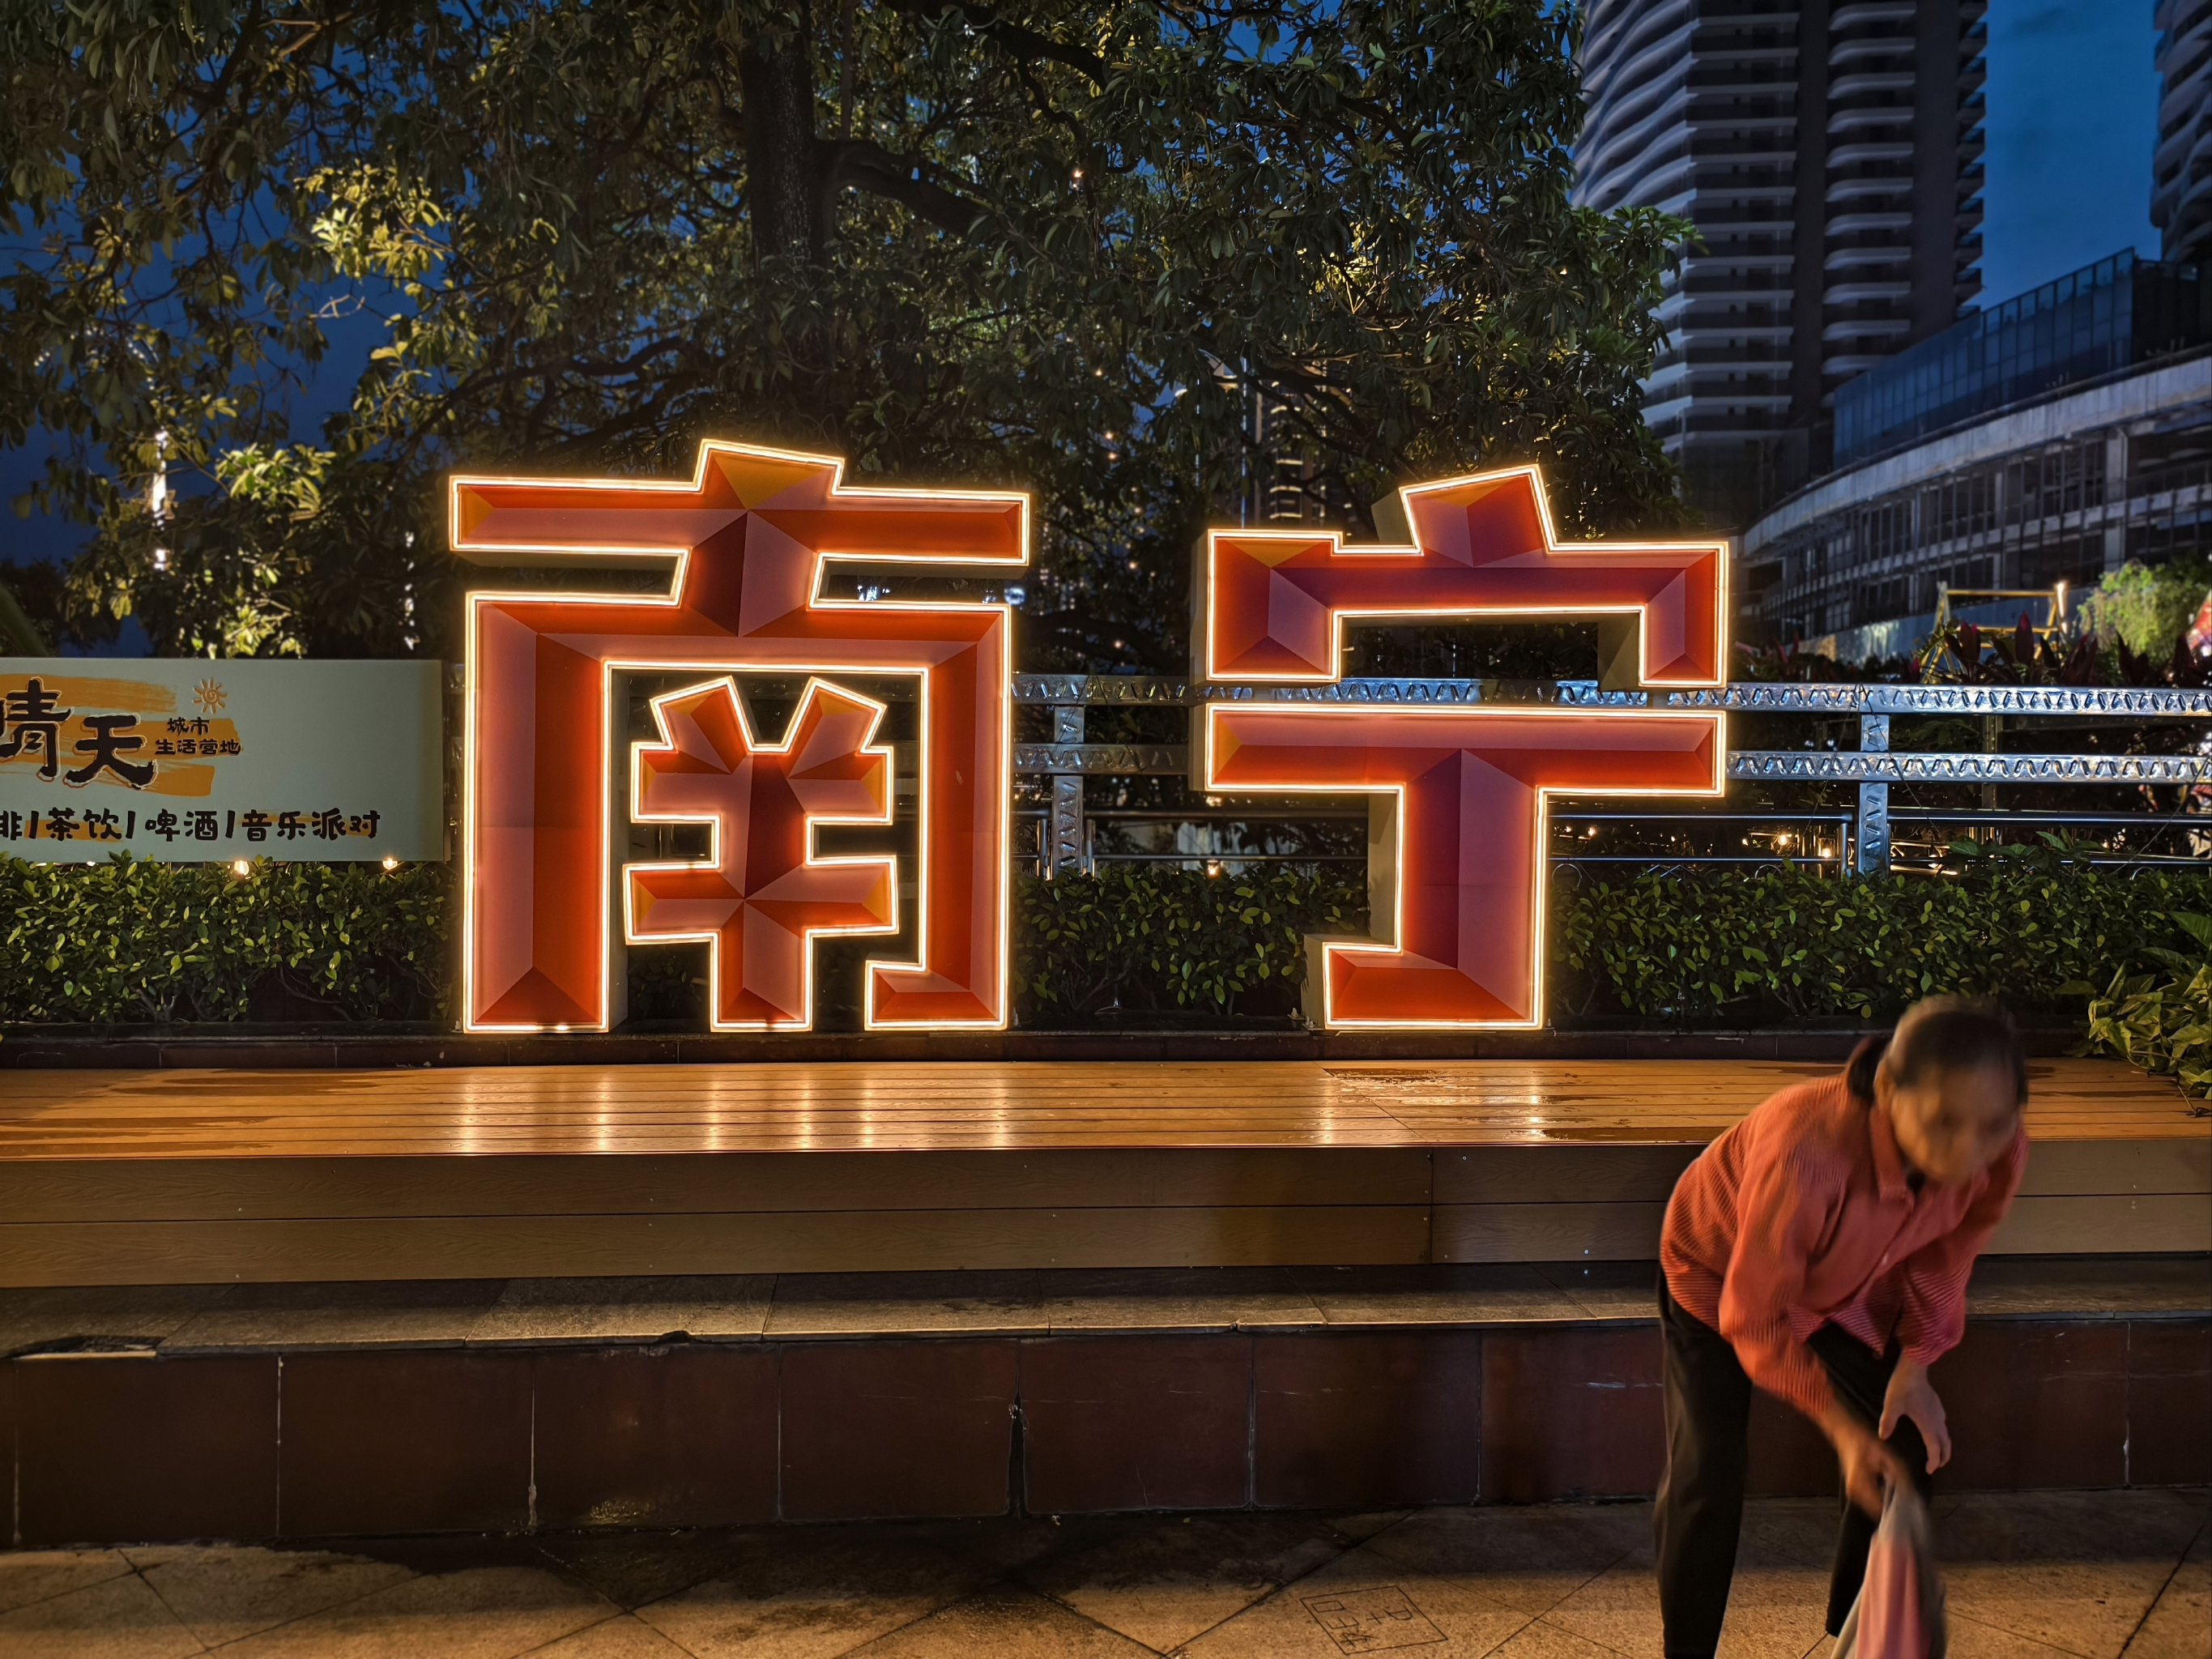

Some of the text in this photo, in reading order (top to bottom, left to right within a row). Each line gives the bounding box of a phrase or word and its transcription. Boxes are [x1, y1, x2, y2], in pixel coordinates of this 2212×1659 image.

[165, 716, 211, 736] 城市
[448, 438, 1730, 1034] 南宁
[154, 738, 242, 756] 生活营地
